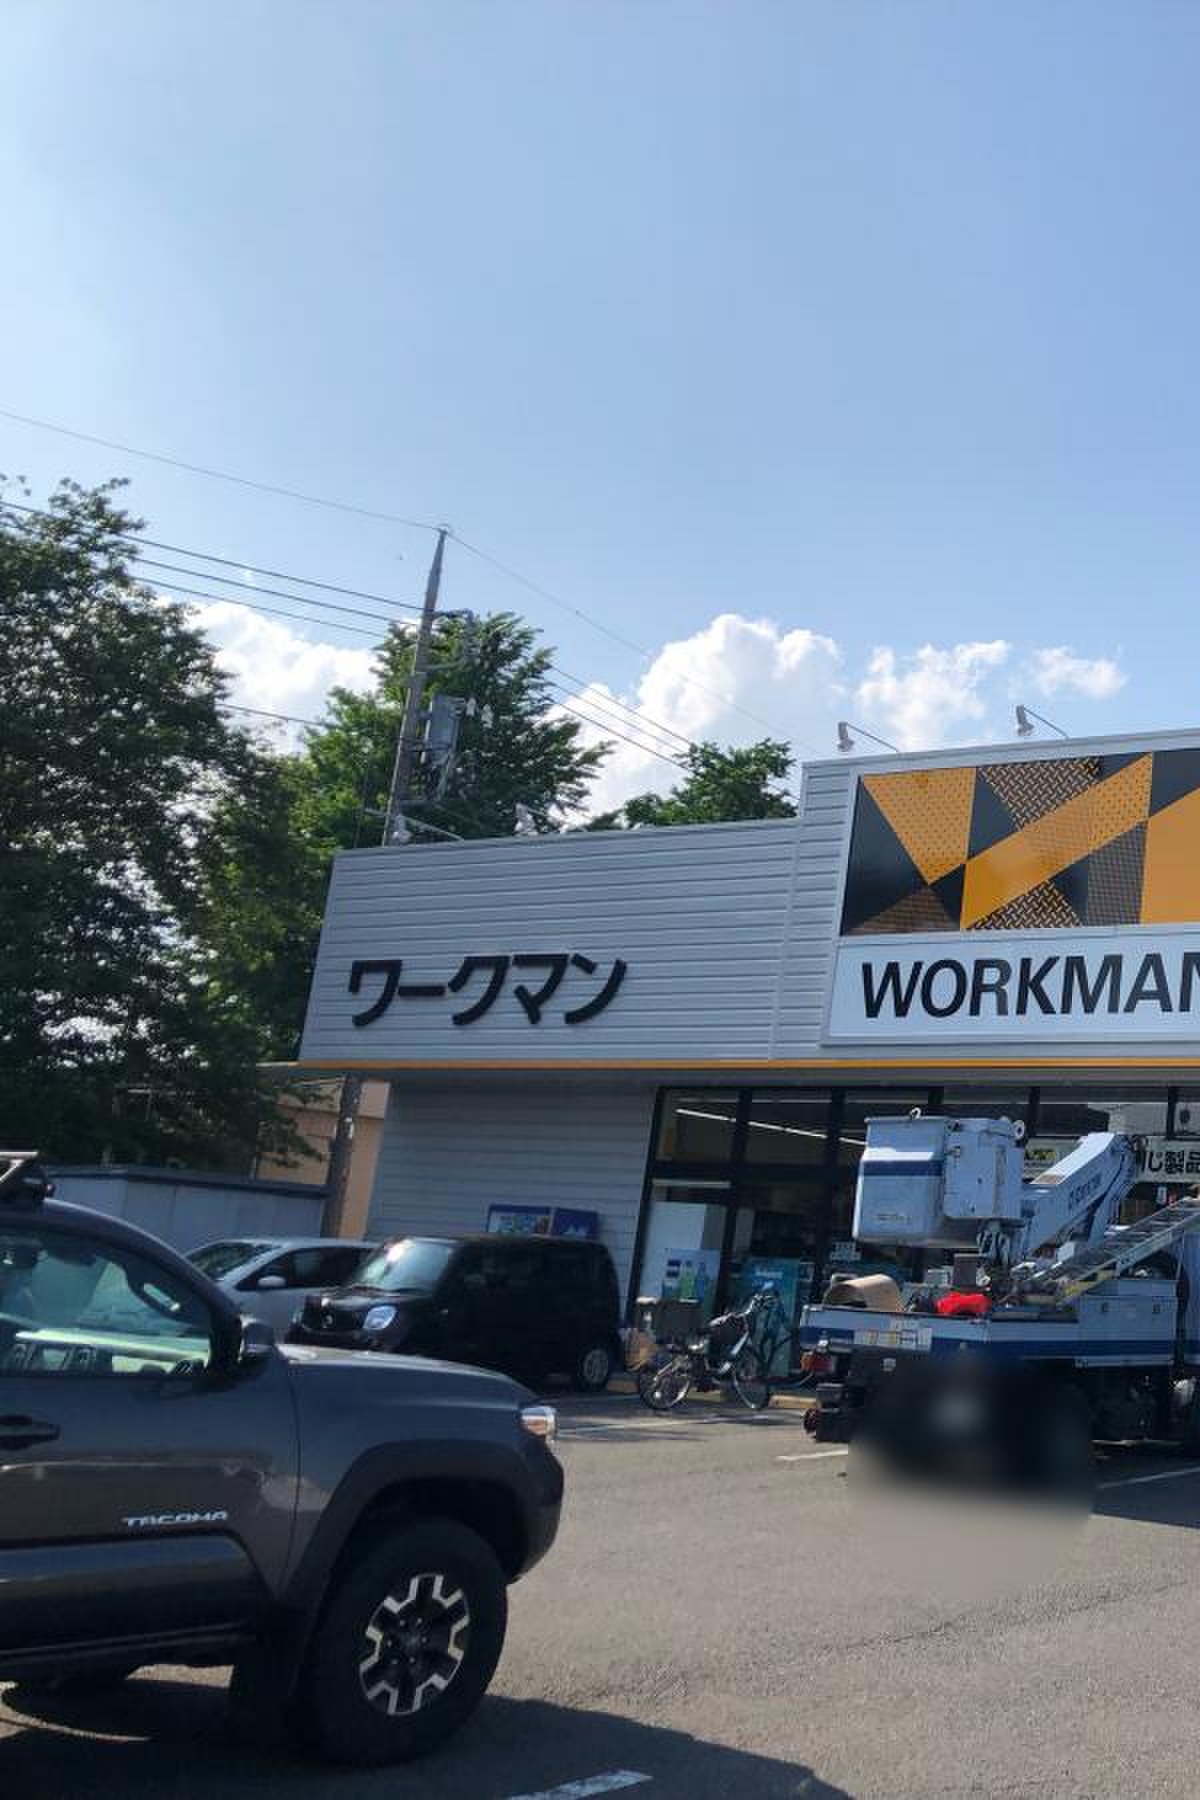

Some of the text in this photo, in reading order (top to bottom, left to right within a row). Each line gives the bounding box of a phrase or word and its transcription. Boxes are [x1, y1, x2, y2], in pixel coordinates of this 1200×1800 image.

[348, 954, 627, 1027] ワークマン
[121, 1511, 228, 1526] TACOMA
